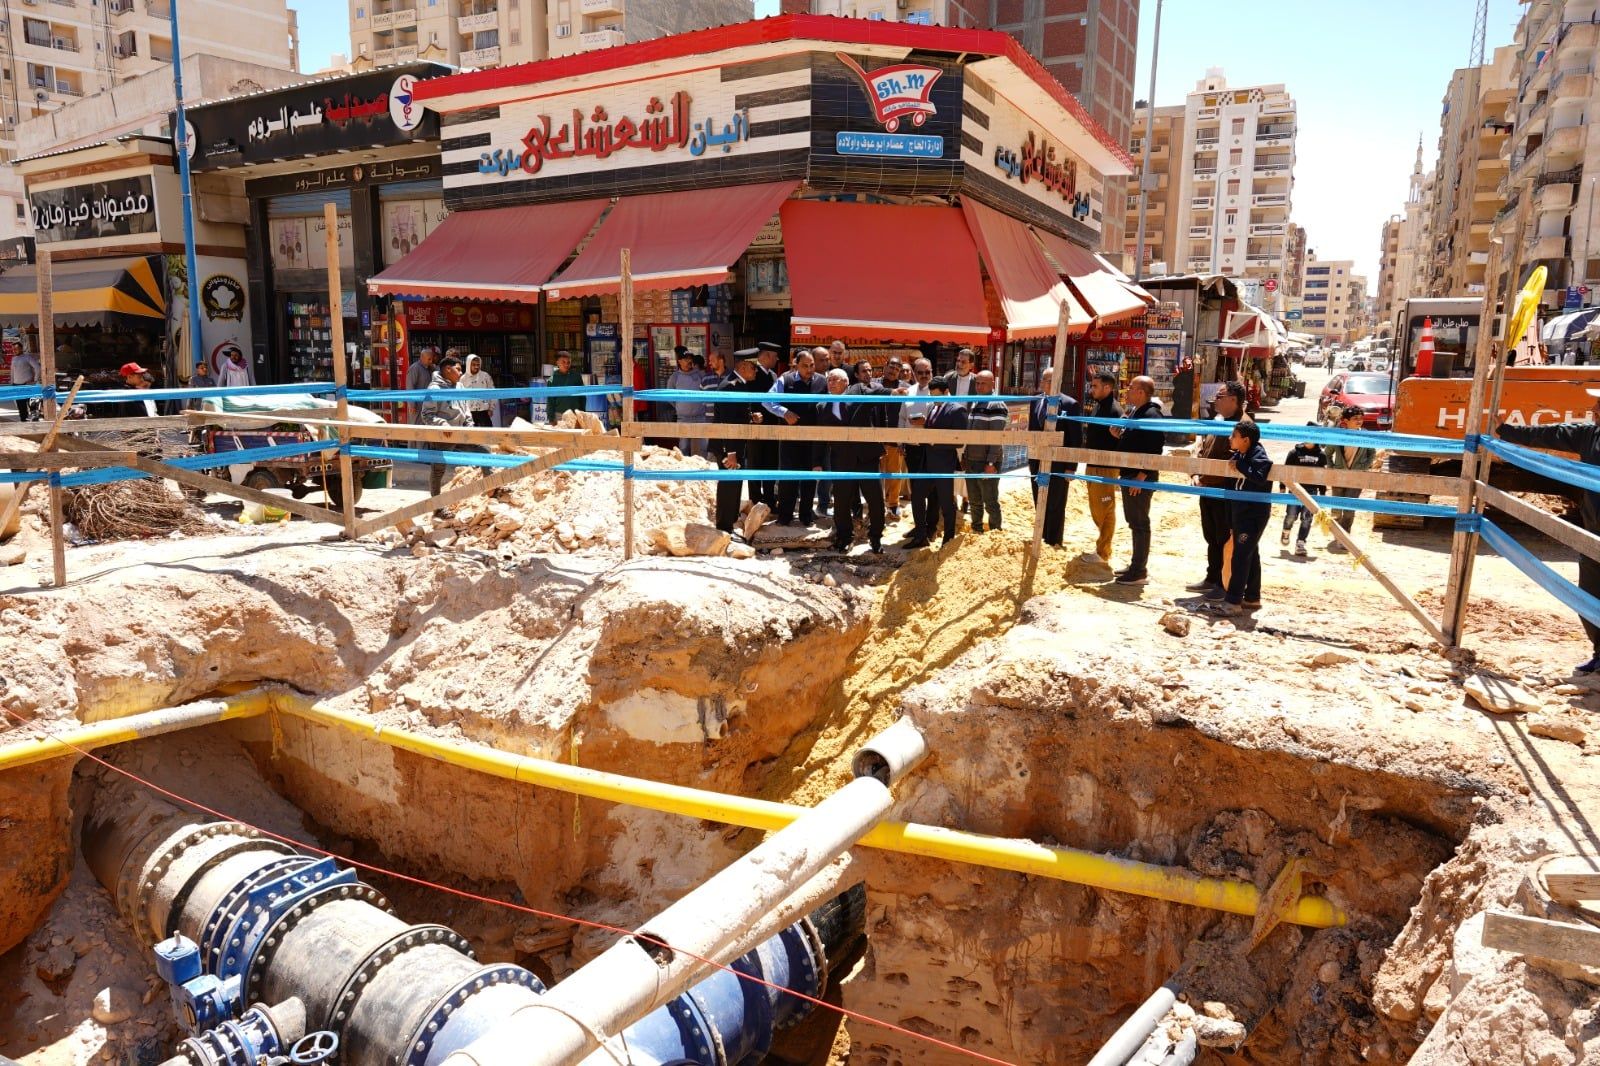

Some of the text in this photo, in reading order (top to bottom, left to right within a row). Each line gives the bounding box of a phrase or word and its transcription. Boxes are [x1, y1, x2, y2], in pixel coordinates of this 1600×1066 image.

[248, 105, 288, 142] الروم
[290, 101, 322, 135] علم
[296, 163, 429, 190] صيدلية علم الروم
[42, 200, 66, 230] زمان
[68, 196, 90, 227] خير
[92, 190, 148, 222] مخبوزات
